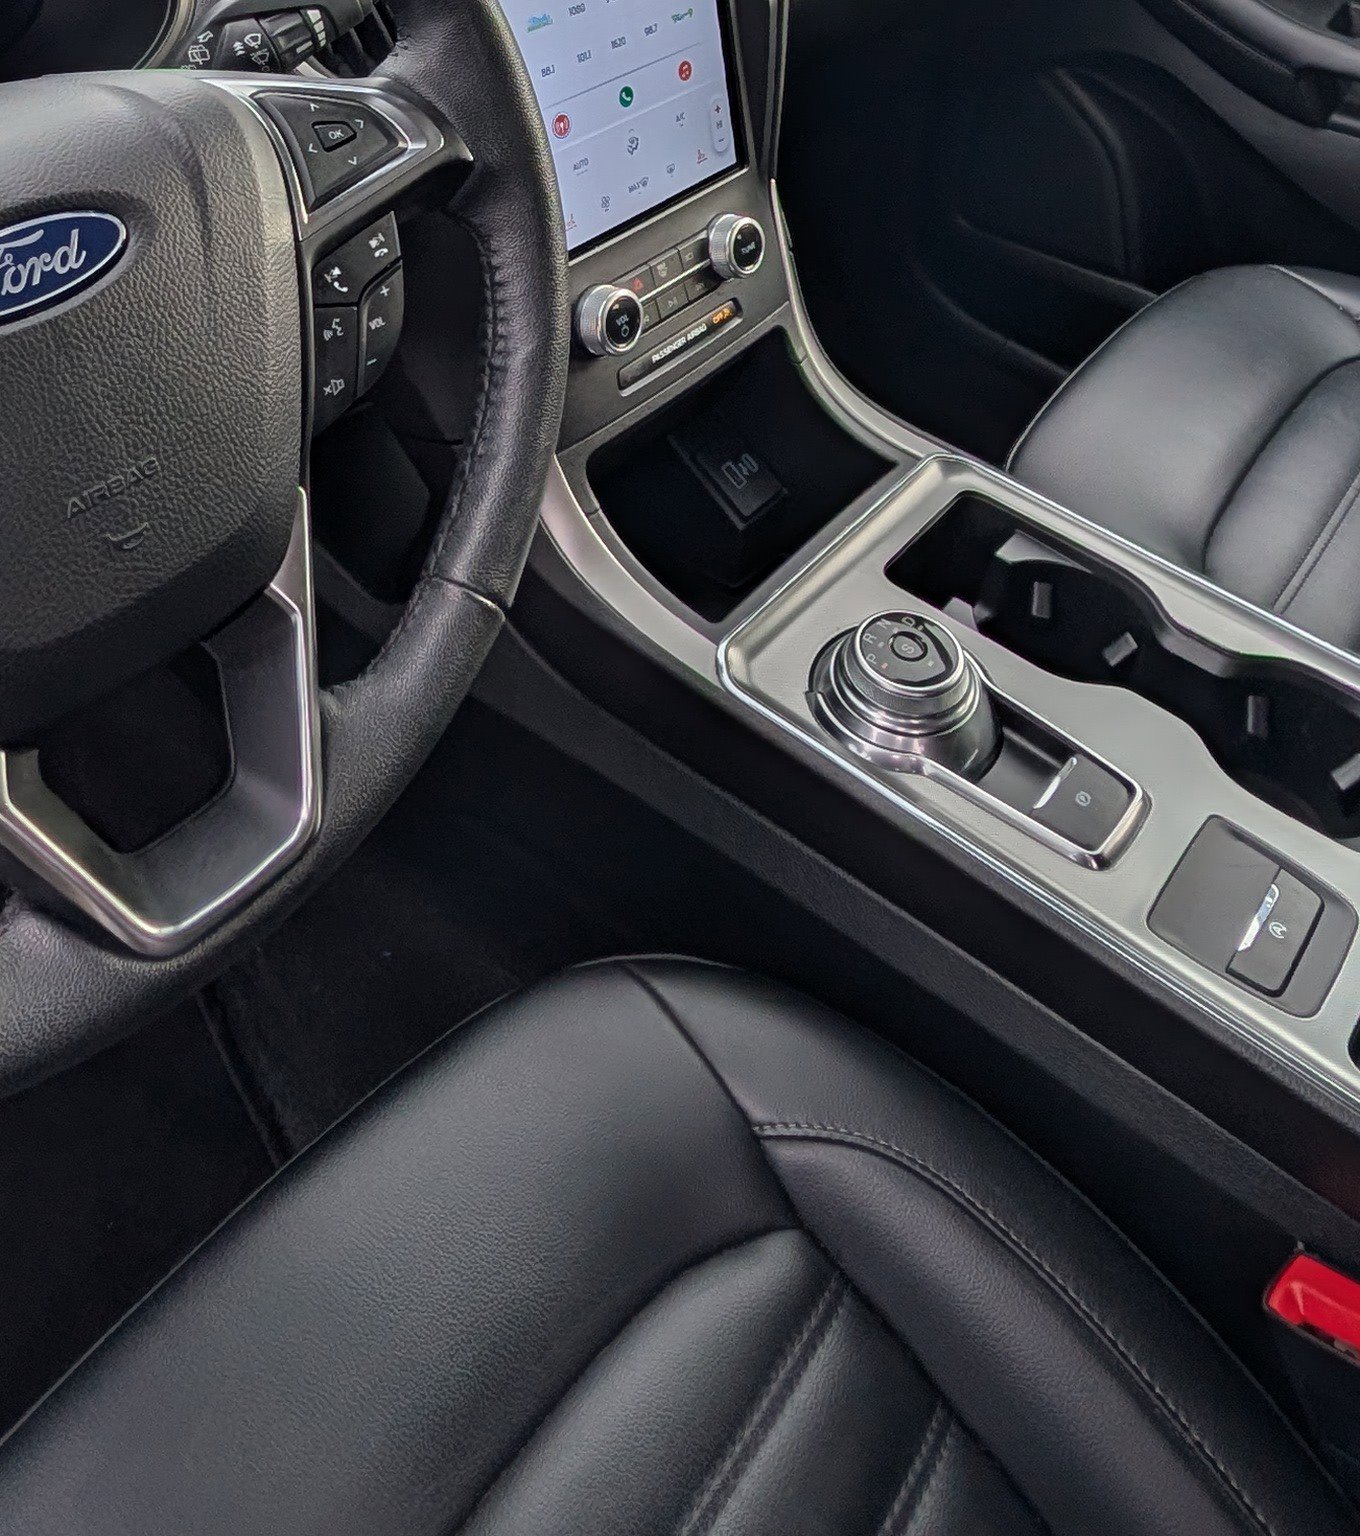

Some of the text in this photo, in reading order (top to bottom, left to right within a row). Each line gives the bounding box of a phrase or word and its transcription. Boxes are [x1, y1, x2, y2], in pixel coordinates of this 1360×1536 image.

[328, 128, 344, 140] OK
[368, 315, 386, 331] VOL
[615, 315, 629, 327] VOL
[651, 337, 686, 363] PASSENGER
[901, 616, 916, 628] D
[863, 633, 877, 644] R
[901, 643, 915, 655] S
[866, 653, 877, 665] P
